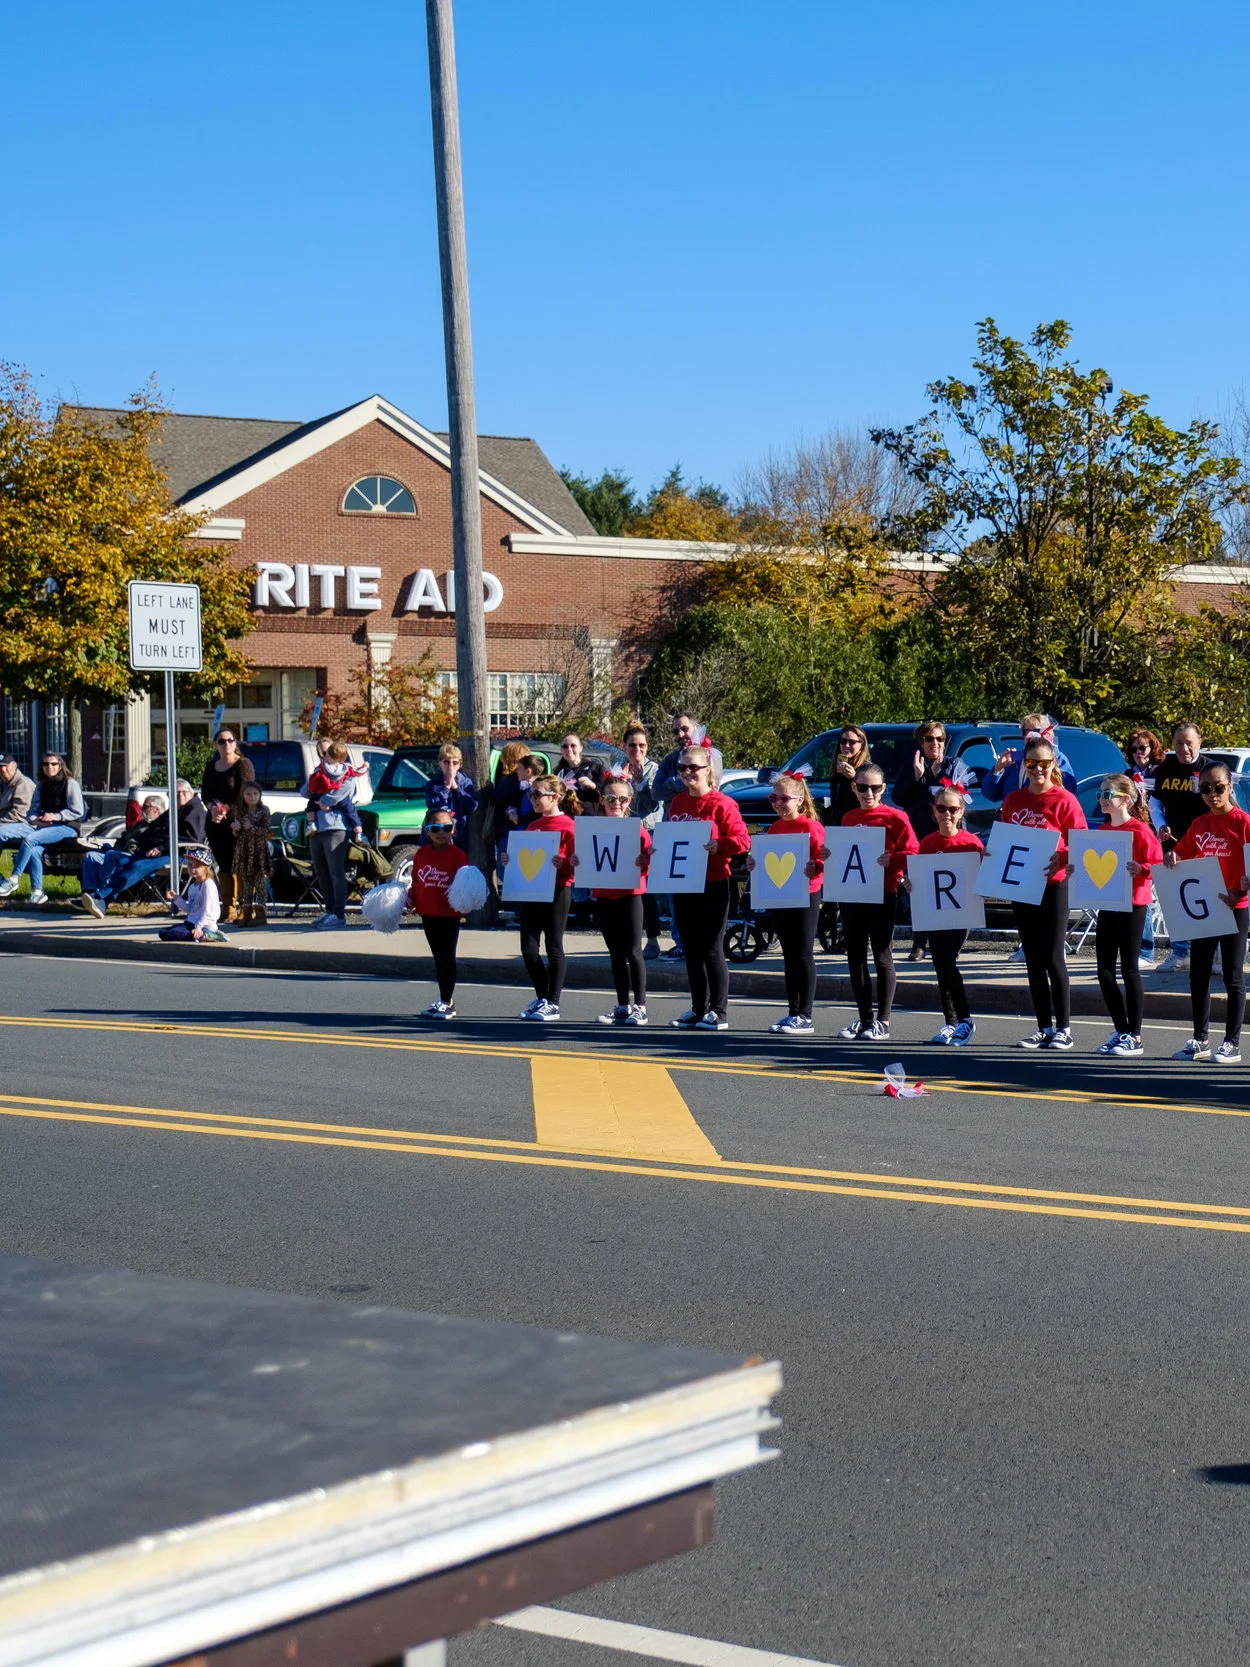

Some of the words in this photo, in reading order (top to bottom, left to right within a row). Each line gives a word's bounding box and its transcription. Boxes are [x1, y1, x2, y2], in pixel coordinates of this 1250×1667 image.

[255, 561, 382, 610] RITE
[137, 594, 163, 608] LEFT
[169, 595, 194, 610] LANE
[149, 618, 186, 636] MUST
[139, 643, 167, 658] TURN
[172, 645, 196, 659] LEFT
[1161, 777, 1193, 792] ARM
[1205, 841, 1217, 849] with
[1218, 842, 1228, 850] all
[1209, 834, 1225, 842] Dance
[592, 834, 620, 873] W
[669, 841, 690, 879] E
[841, 844, 867, 884] A
[1000, 844, 1030, 886] E
[1215, 849, 1232, 857] heart
[933, 870, 962, 910] R
[1179, 878, 1210, 921] G
